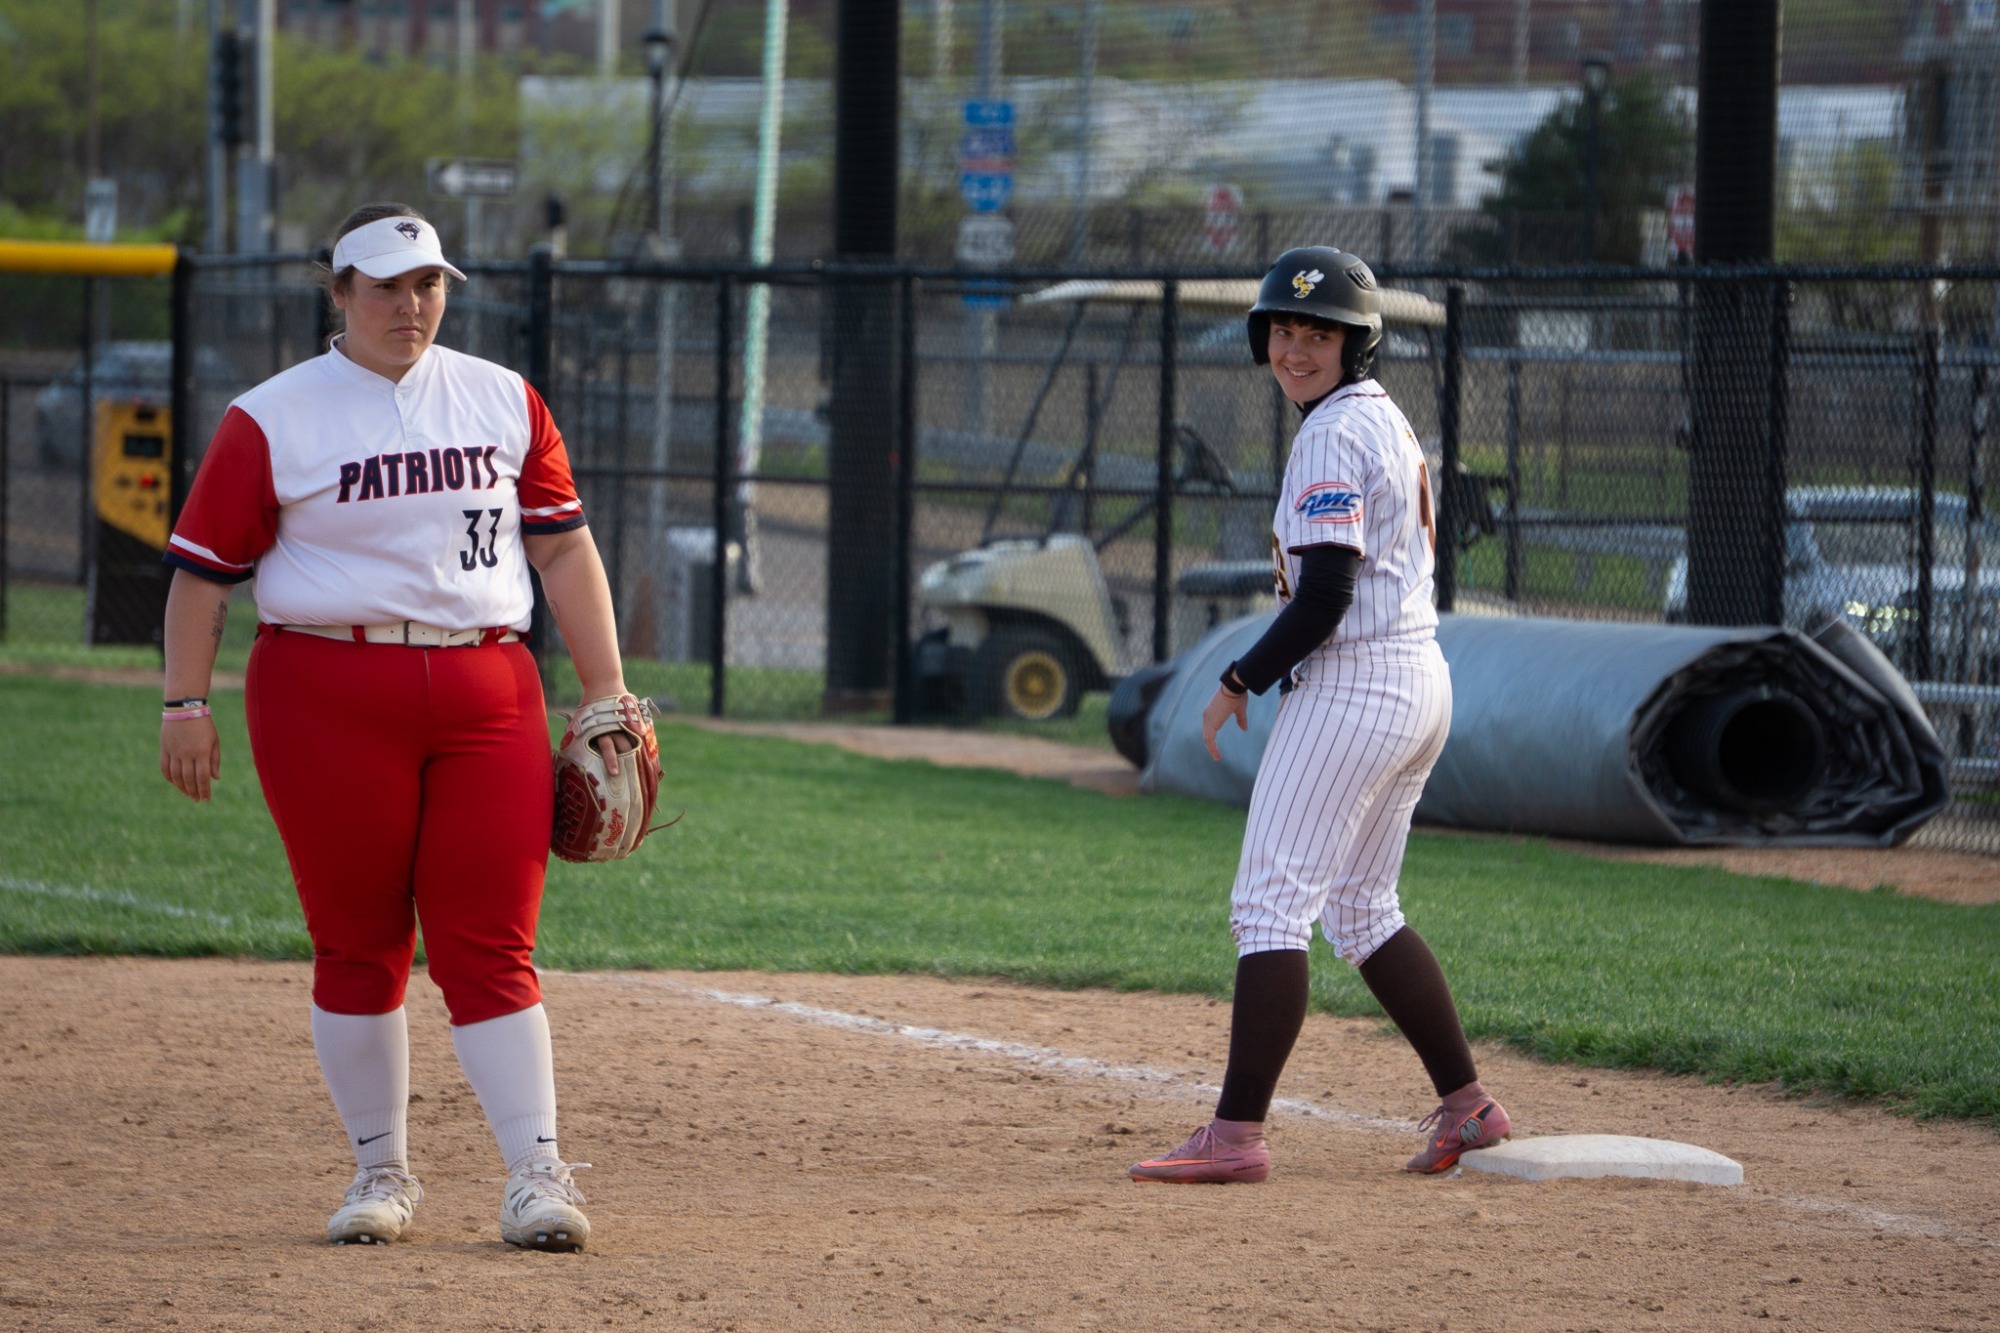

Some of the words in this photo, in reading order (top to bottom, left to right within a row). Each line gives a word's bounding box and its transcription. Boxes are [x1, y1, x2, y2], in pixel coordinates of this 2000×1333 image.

[336, 446, 498, 503] PATRIOTS
[1297, 492, 1361, 517] AMC
[460, 507, 503, 571] 33
